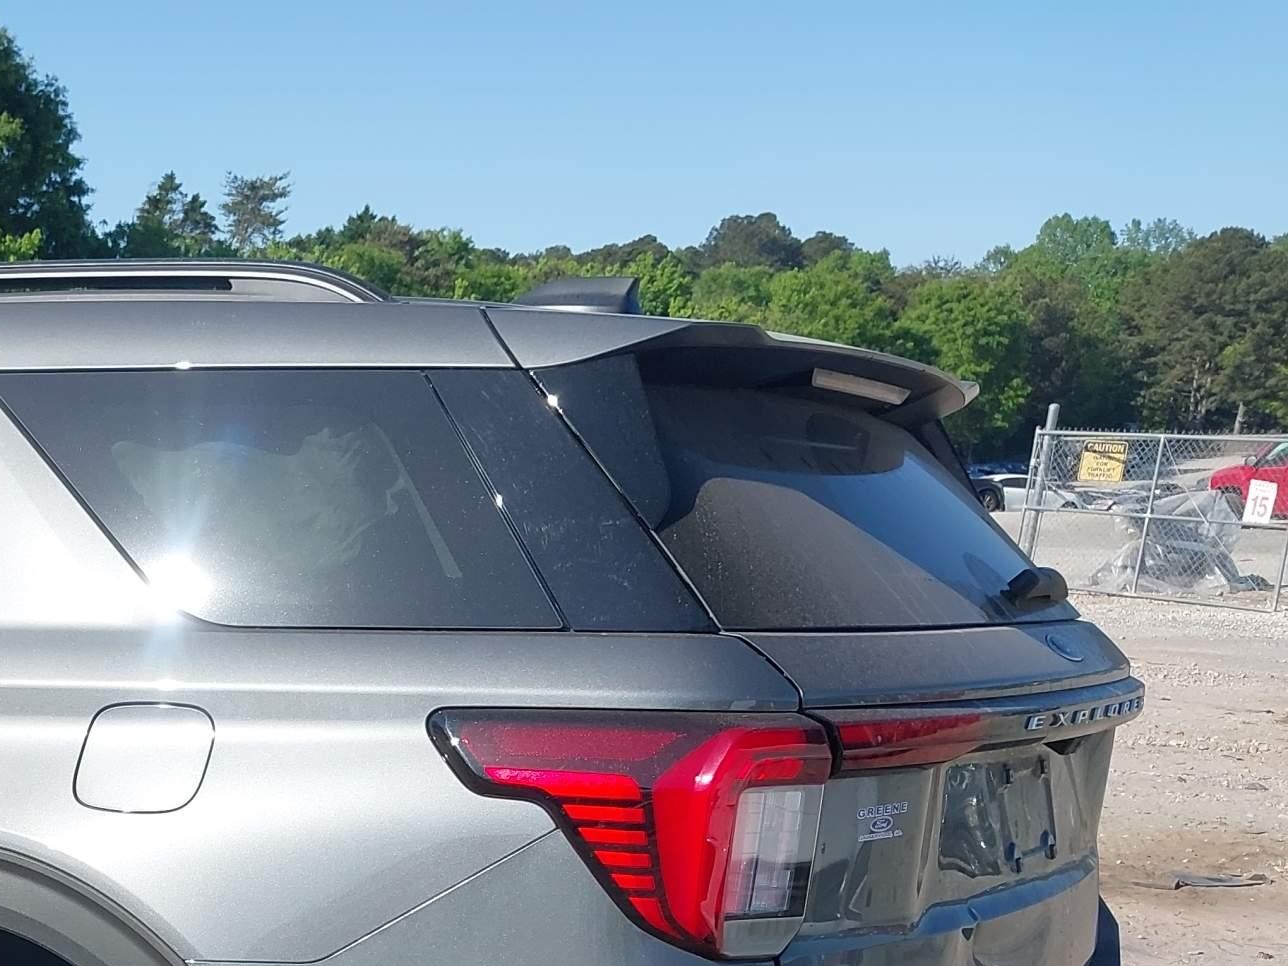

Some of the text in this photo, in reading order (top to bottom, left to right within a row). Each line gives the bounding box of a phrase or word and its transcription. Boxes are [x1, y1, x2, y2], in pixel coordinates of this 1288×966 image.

[1087, 442, 1125, 453] CAUTION
[1251, 495, 1269, 517] 15
[857, 802, 908, 819] GREENE
